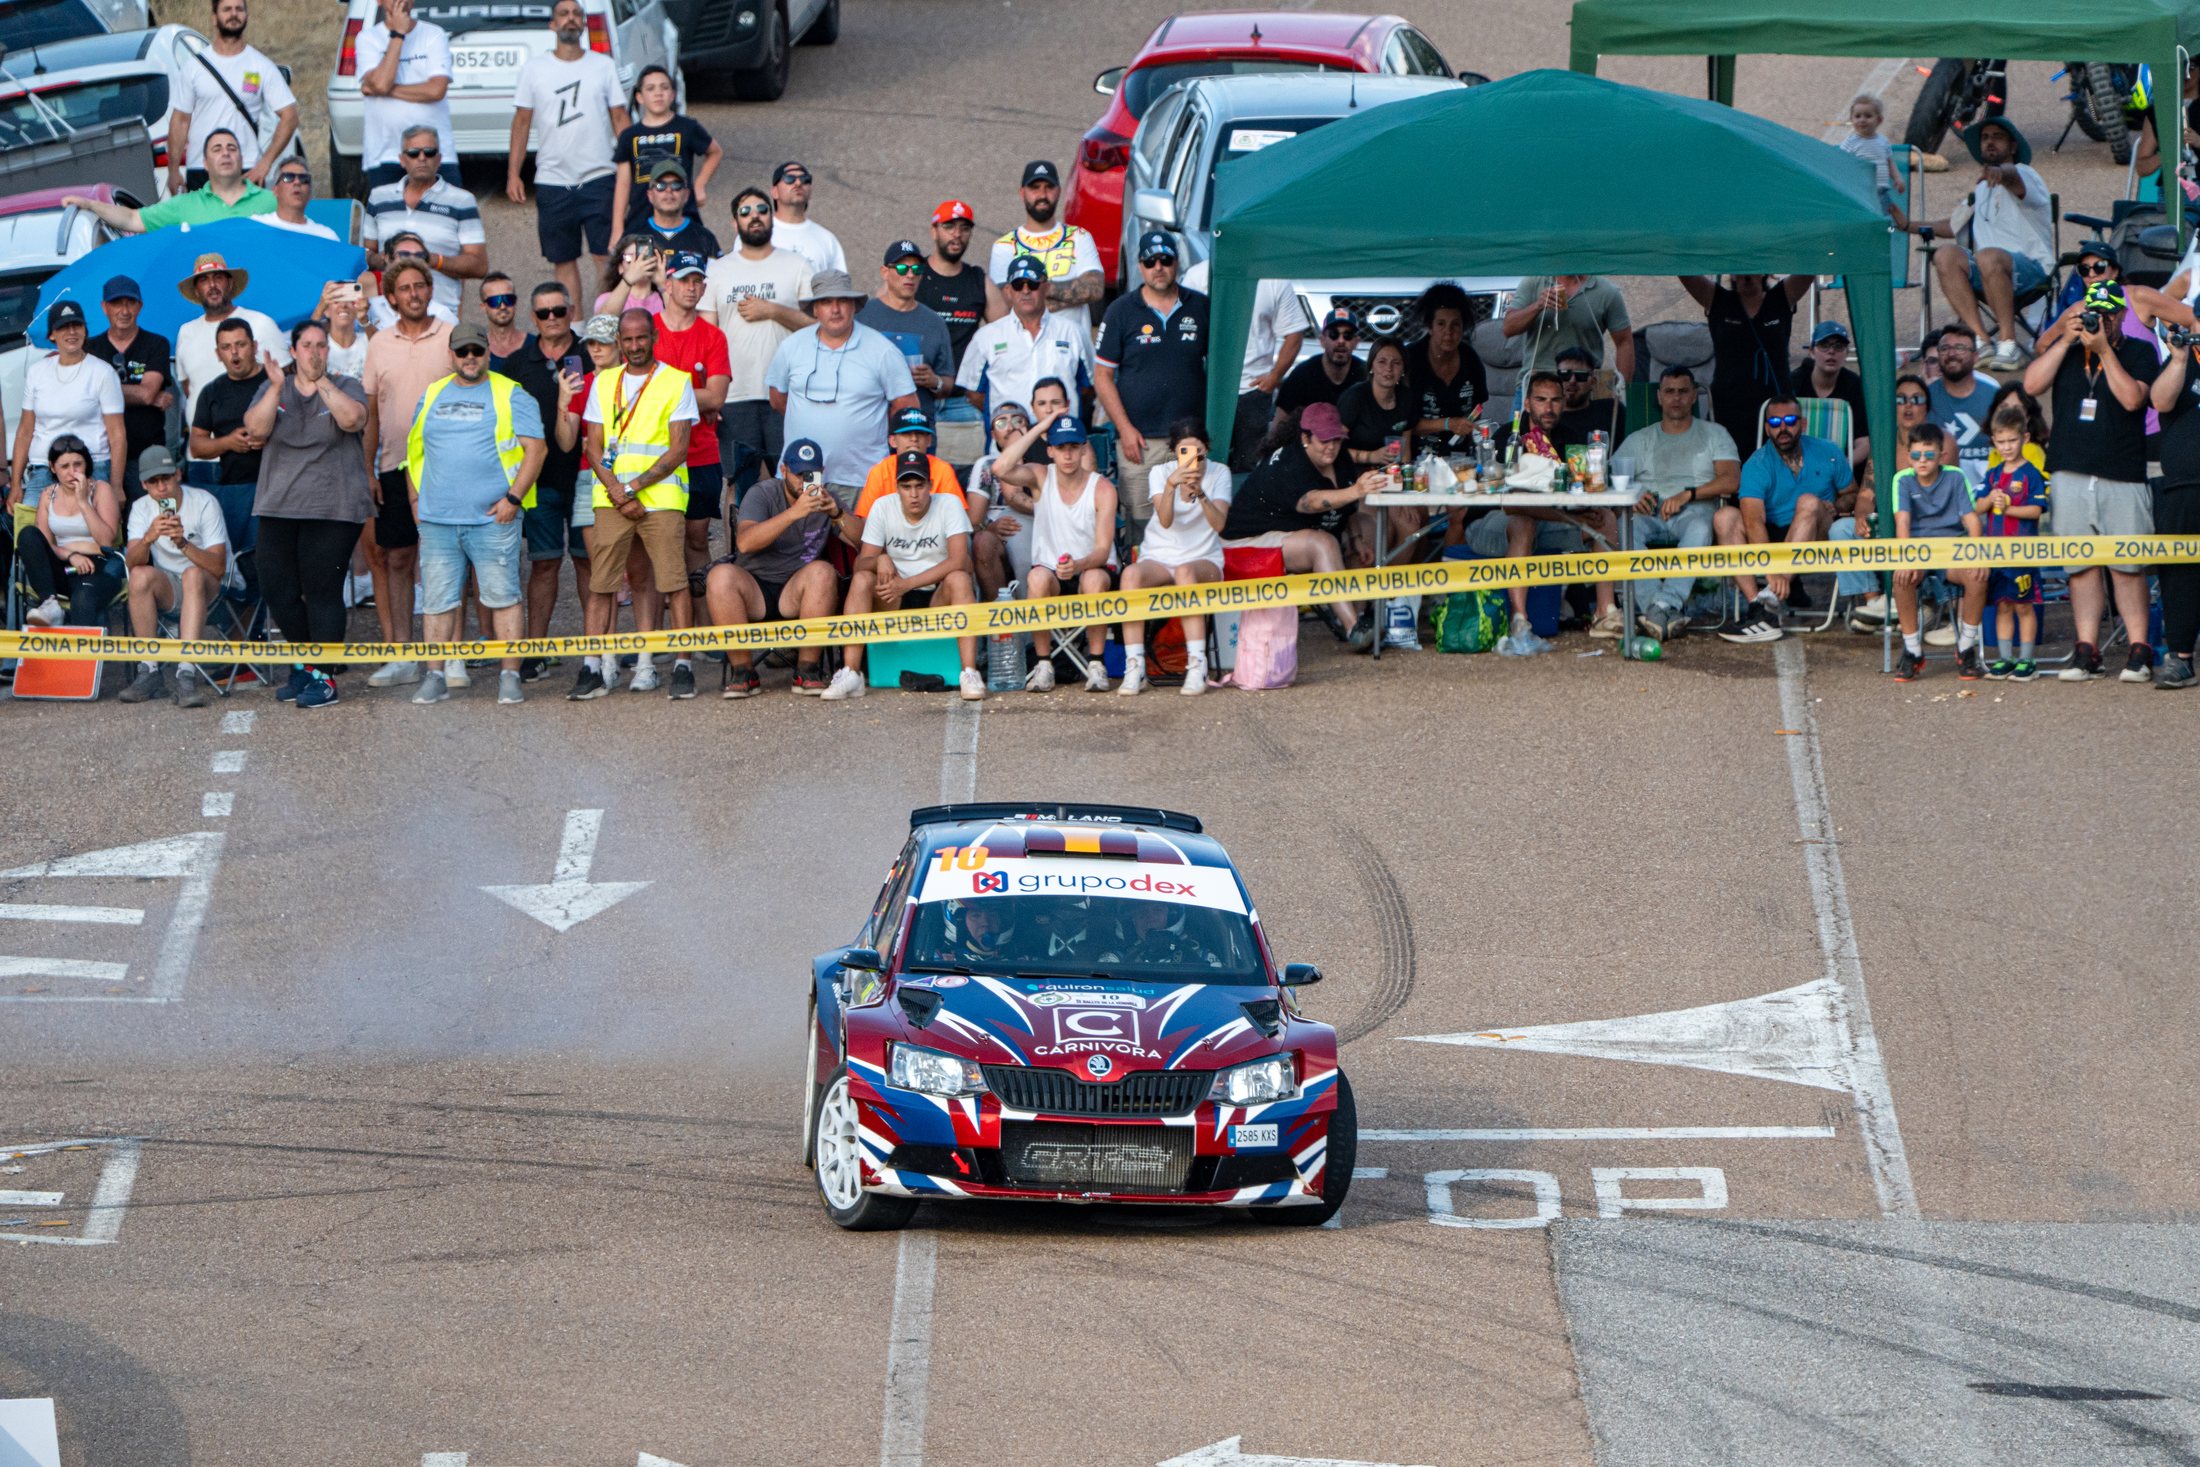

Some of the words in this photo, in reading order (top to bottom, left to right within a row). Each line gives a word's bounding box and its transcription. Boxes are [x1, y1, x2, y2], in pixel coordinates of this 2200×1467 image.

[495, 51, 518, 67] GU
[732, 284, 756, 293] MODO
[761, 282, 774, 291] FIN
[727, 294, 737, 304] DE
[1792, 547, 1844, 565] ZONA
[1849, 544, 1932, 564] PUBLICO
[1953, 543, 2005, 561] ZONA
[2012, 542, 2094, 560] PUBLICO
[2115, 541, 2168, 557] ZONA
[2173, 541, 2200, 557] PU
[1469, 563, 1522, 583] ZONA
[1526, 558, 1610, 579] PUBLICO
[1630, 554, 1682, 573] ZONA
[1687, 549, 1772, 569] PUBLICO
[1309, 575, 1361, 597] ZONA
[1366, 567, 1449, 591] PUBLICO
[2015, 574, 2032, 592] 10
[1149, 589, 1201, 612] ZONA
[1206, 581, 1289, 606] PUBLICO
[989, 605, 1041, 628] ZONA
[1046, 597, 1128, 622] PUBLICO
[828, 618, 881, 639] ZONA
[885, 611, 968, 634] PUBLICO
[19, 635, 72, 652] ZONA
[77, 638, 162, 655] PUBLICO
[506, 639, 558, 653] ZONA
[564, 636, 647, 651] PUBLICO
[668, 632, 719, 648] ZONA
[724, 626, 808, 645] PUBLICO
[180, 641, 234, 655] ZONA
[240, 643, 323, 657] PUBLICO
[343, 643, 397, 657] ZONA
[402, 642, 485, 656] PUBLICO
[935, 846, 989, 872] 10
[1018, 873, 1197, 899] grupodex
[1065, 1011, 1123, 1036] C
[1034, 1042, 1162, 1059] CARNIVORA
[1237, 1130, 1258, 1142] 2585
[1262, 1129, 1276, 1141] KXS
[1323, 1166, 1728, 1229] OP
